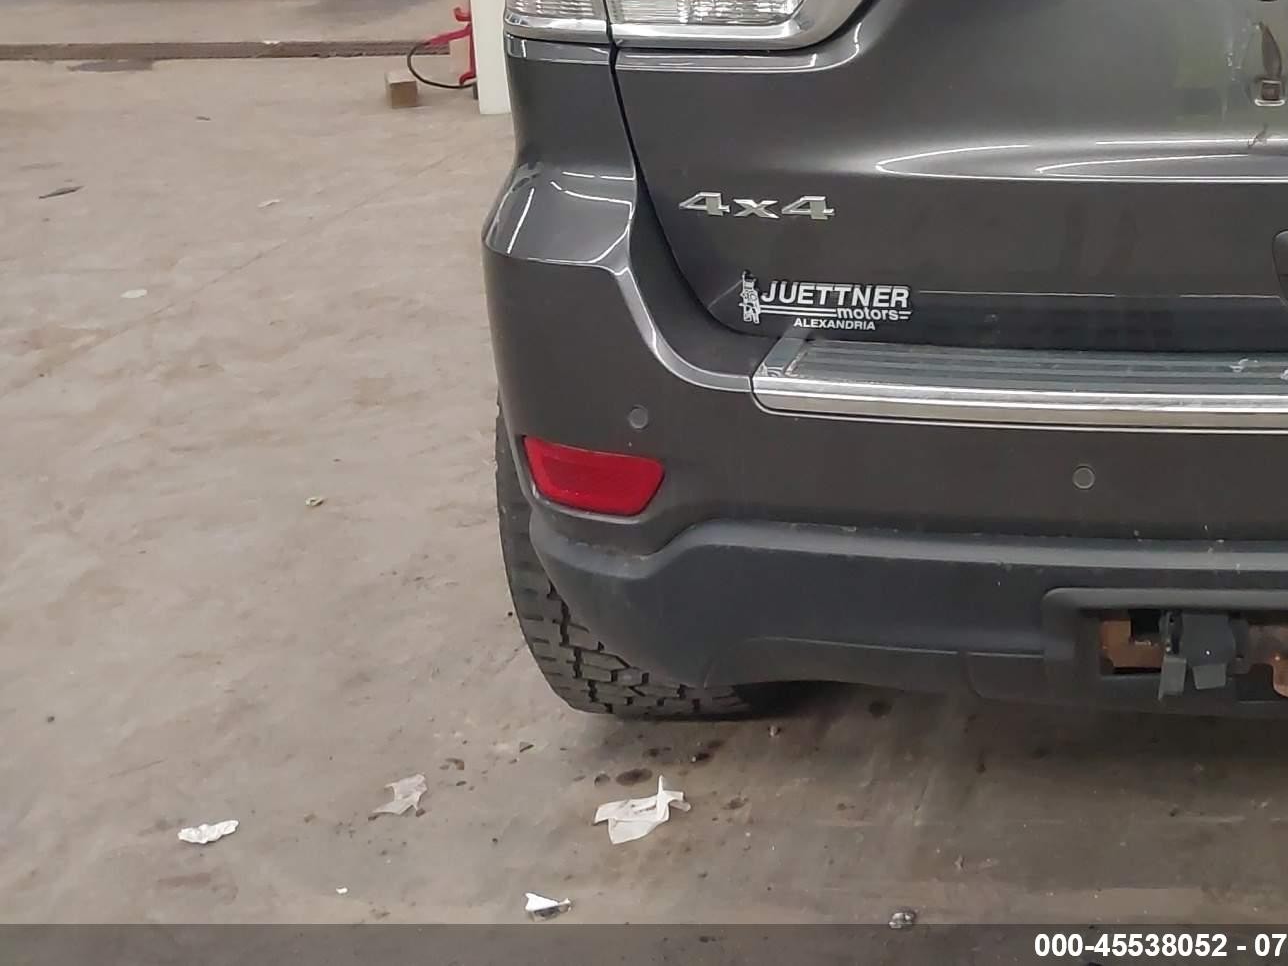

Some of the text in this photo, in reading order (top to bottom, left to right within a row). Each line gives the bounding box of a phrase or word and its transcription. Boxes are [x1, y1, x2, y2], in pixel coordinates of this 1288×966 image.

[678, 191, 836, 221] 4x4
[761, 280, 911, 309] JUETTNER
[793, 317, 876, 331] ALEXANDRIA
[836, 306, 899, 321] motors
